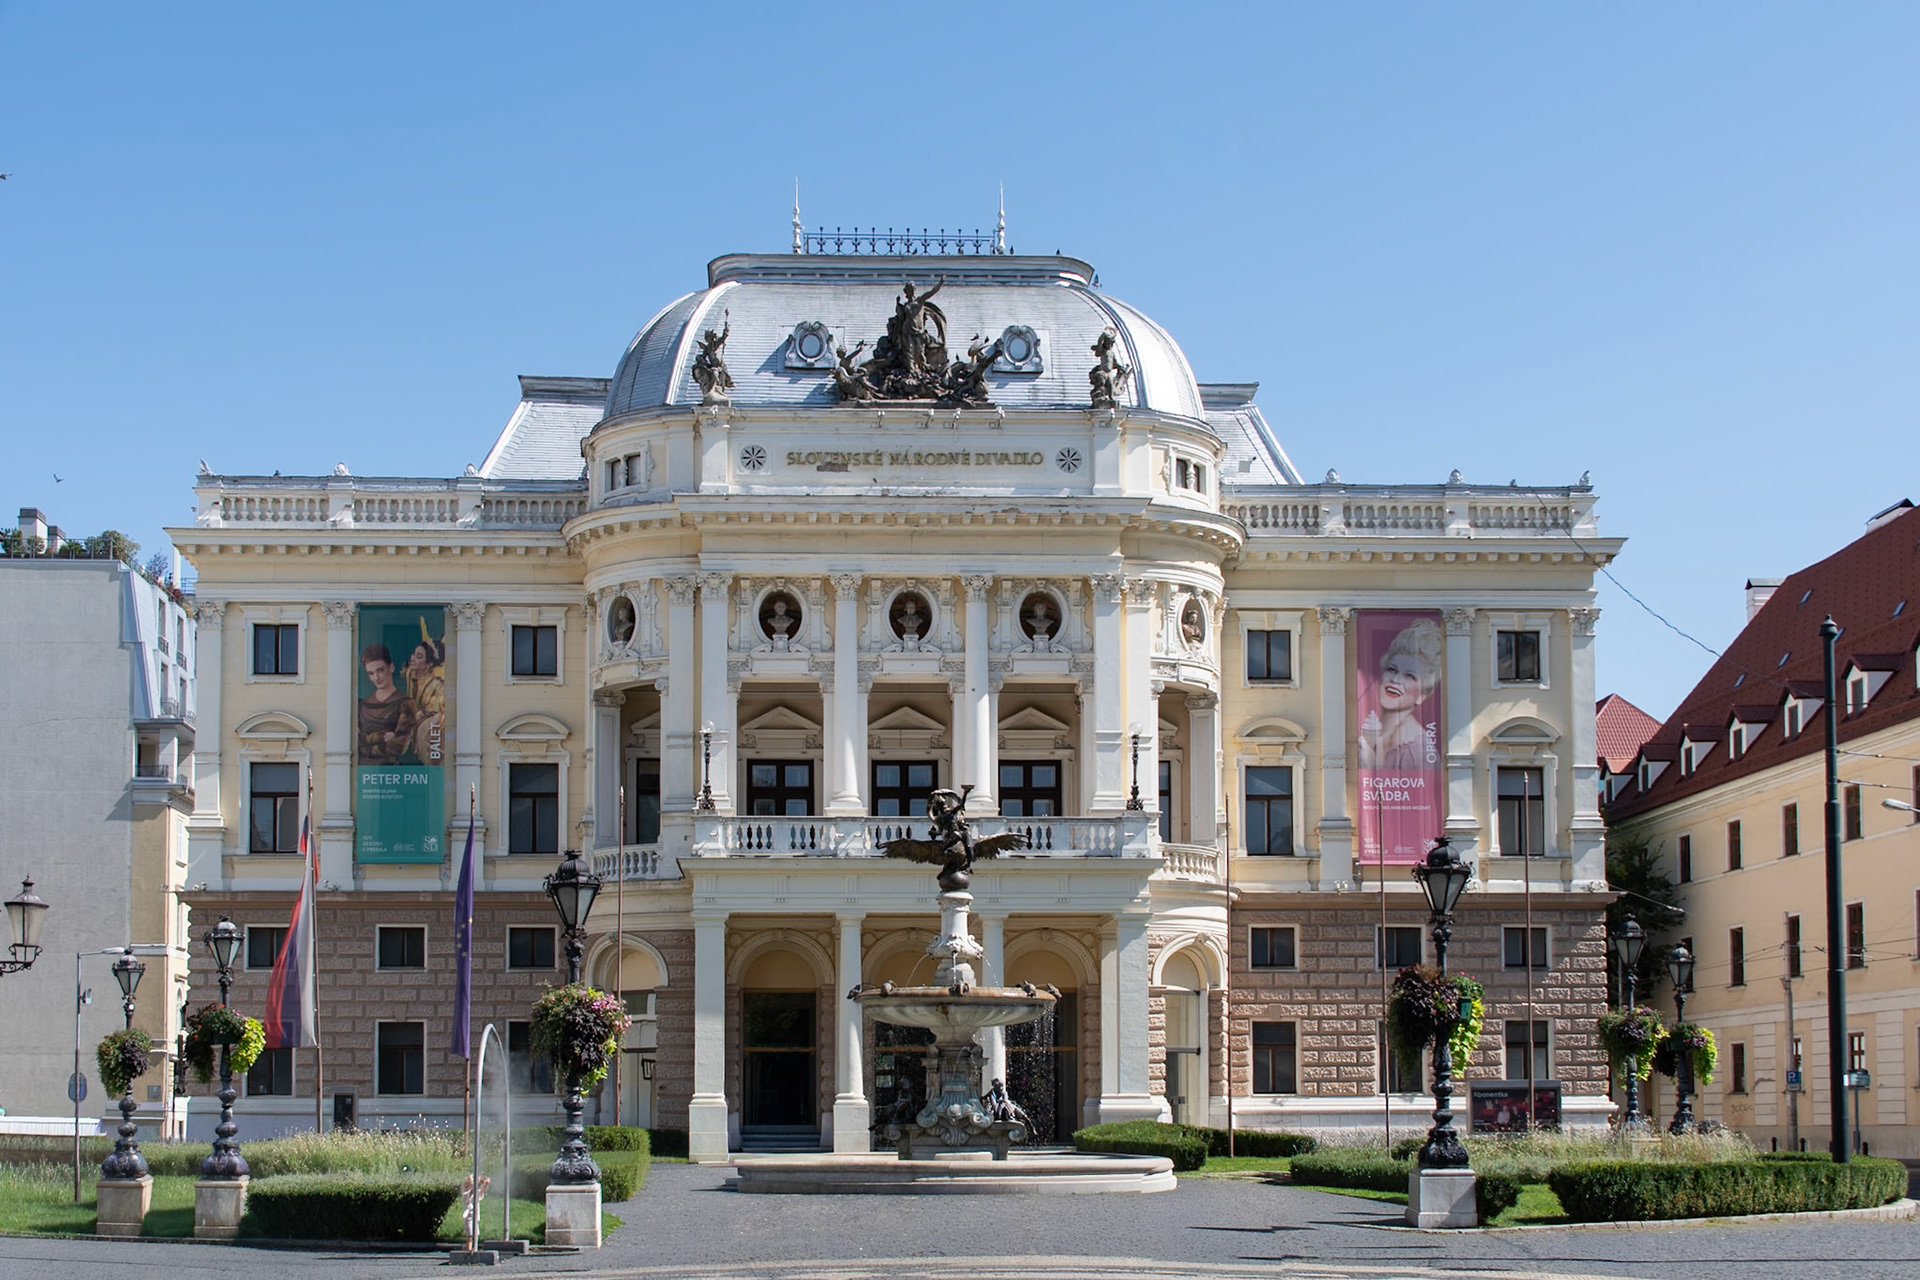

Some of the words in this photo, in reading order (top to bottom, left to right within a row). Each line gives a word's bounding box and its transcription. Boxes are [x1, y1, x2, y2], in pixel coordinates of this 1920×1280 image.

[787, 449, 883, 466] SLOVENSKÉ
[889, 449, 971, 466] NÁRODNÉ
[975, 452, 1044, 466] DIVADLO
[430, 722, 441, 759] BALET
[1426, 721, 1437, 763] OPERA
[362, 773, 401, 785] PETER
[403, 773, 428, 785] PAN
[1363, 777, 1425, 788] FIGAROVA
[1363, 790, 1410, 802] SVADBA
